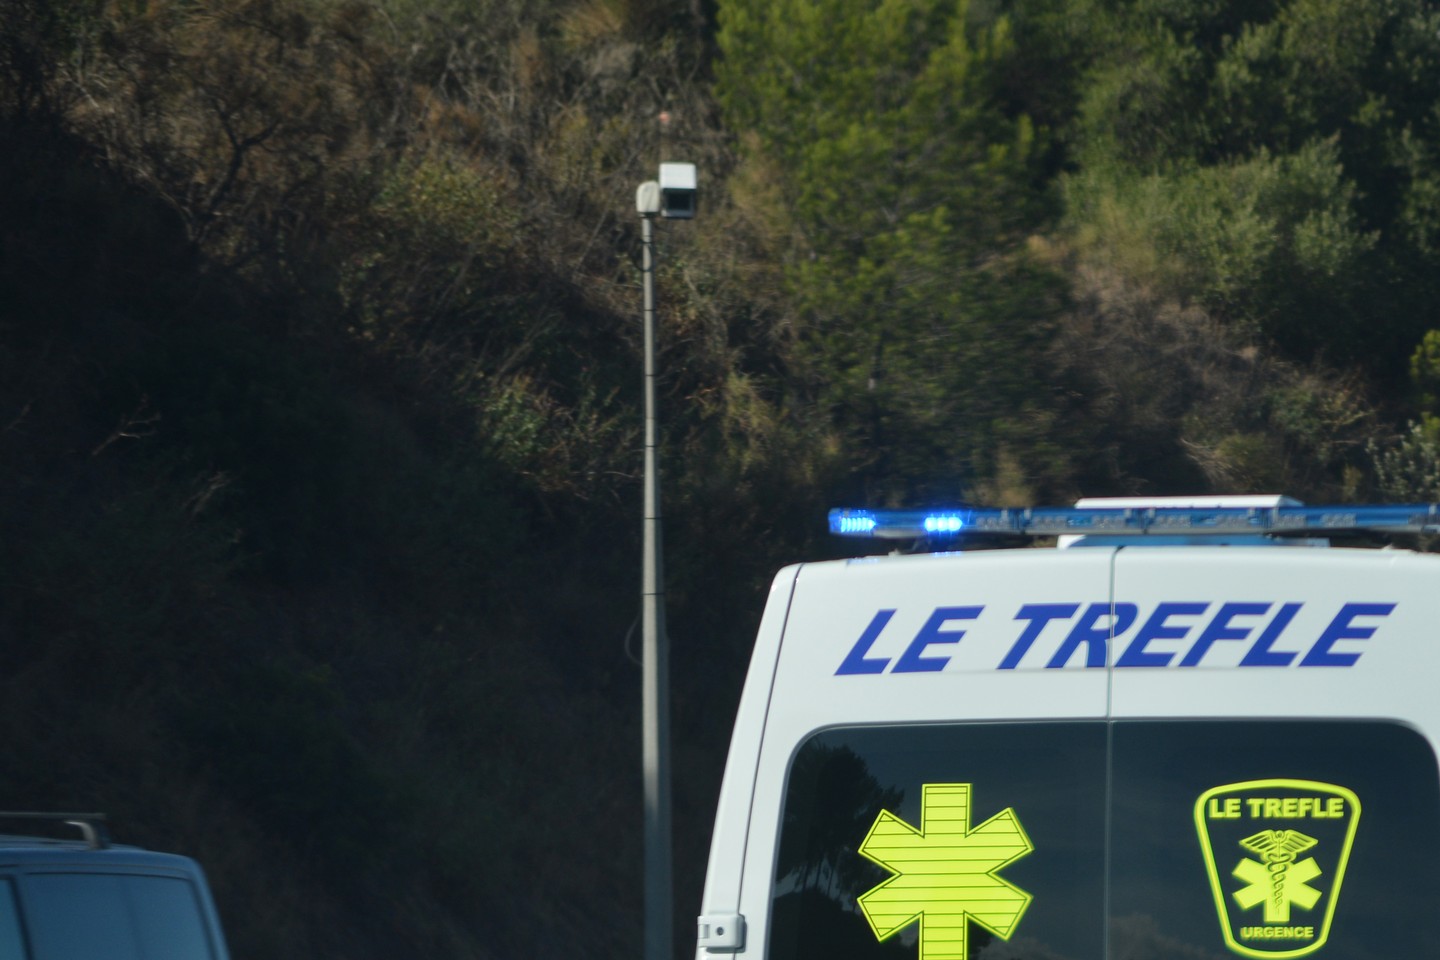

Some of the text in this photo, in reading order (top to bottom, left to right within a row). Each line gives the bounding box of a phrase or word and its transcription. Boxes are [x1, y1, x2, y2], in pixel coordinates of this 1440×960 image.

[835, 601, 1399, 676] LE TREFLE
[1209, 797, 1345, 820] LE TREFLE
[1240, 925, 1315, 940] URGENCE
